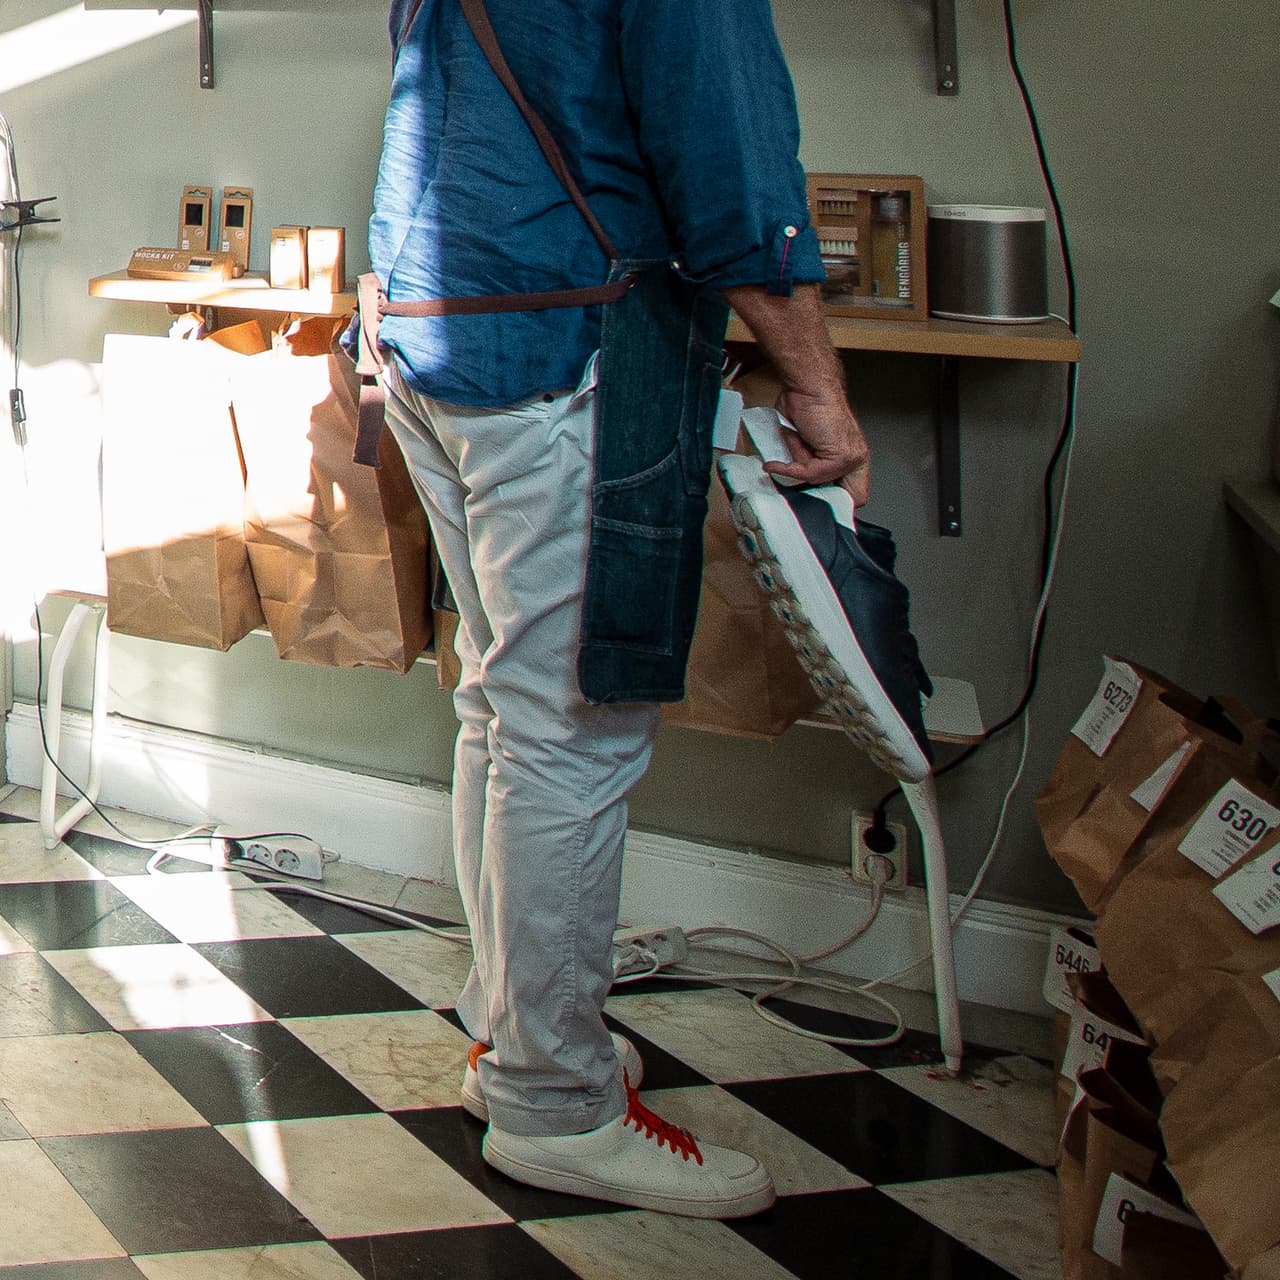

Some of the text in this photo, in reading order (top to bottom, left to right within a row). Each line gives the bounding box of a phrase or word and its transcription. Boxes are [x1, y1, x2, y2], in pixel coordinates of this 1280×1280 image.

[898, 241, 911, 298] RENGÖRING
[1103, 680, 1133, 713] 6273
[1217, 799, 1275, 841] 630
[1082, 1022, 1113, 1051] 64
